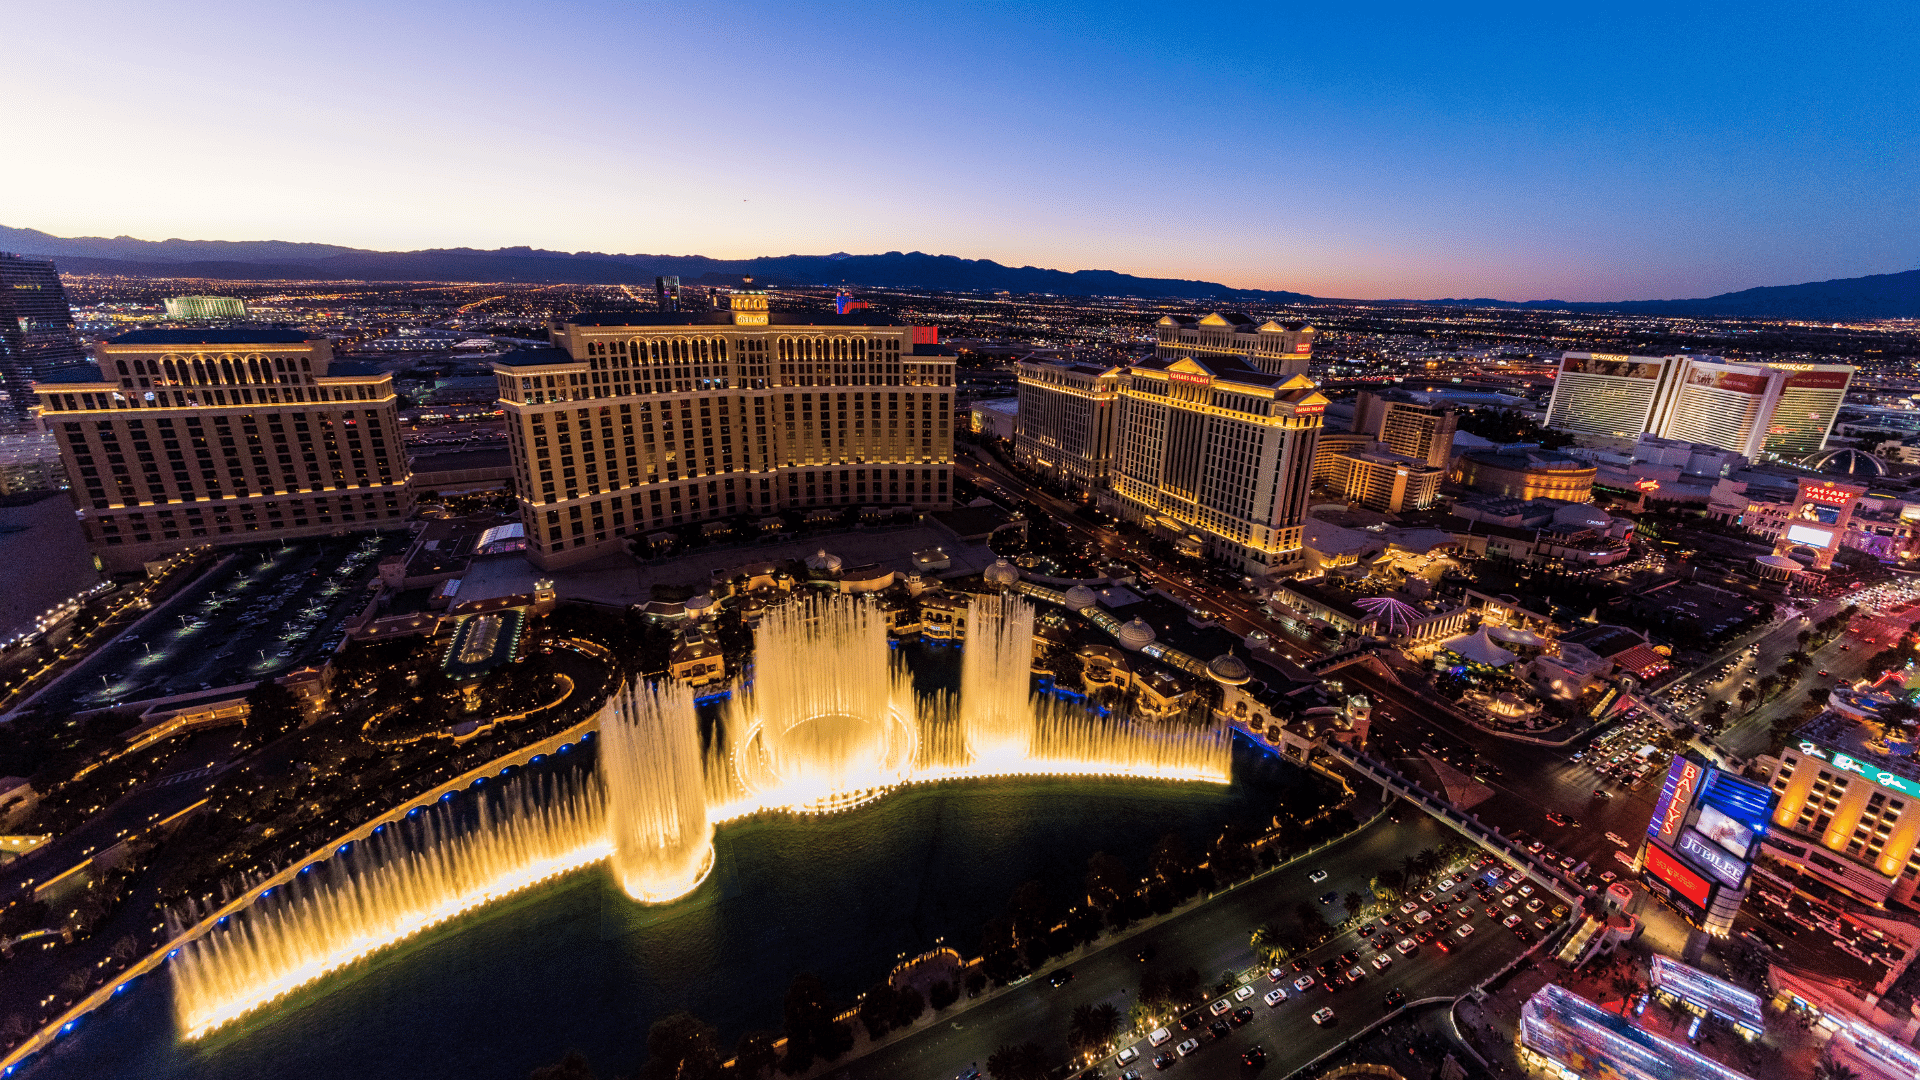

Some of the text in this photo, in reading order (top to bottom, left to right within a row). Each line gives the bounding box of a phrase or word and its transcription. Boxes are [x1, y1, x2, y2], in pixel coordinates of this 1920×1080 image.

[1776, 363, 1815, 371] MIRAGE
[1170, 373, 1210, 385] CAESARS PALACE
[1806, 487, 1852, 498] CAESARS
[1806, 493, 1846, 504] PALACE
[1680, 836, 1744, 881] JUBILEE
